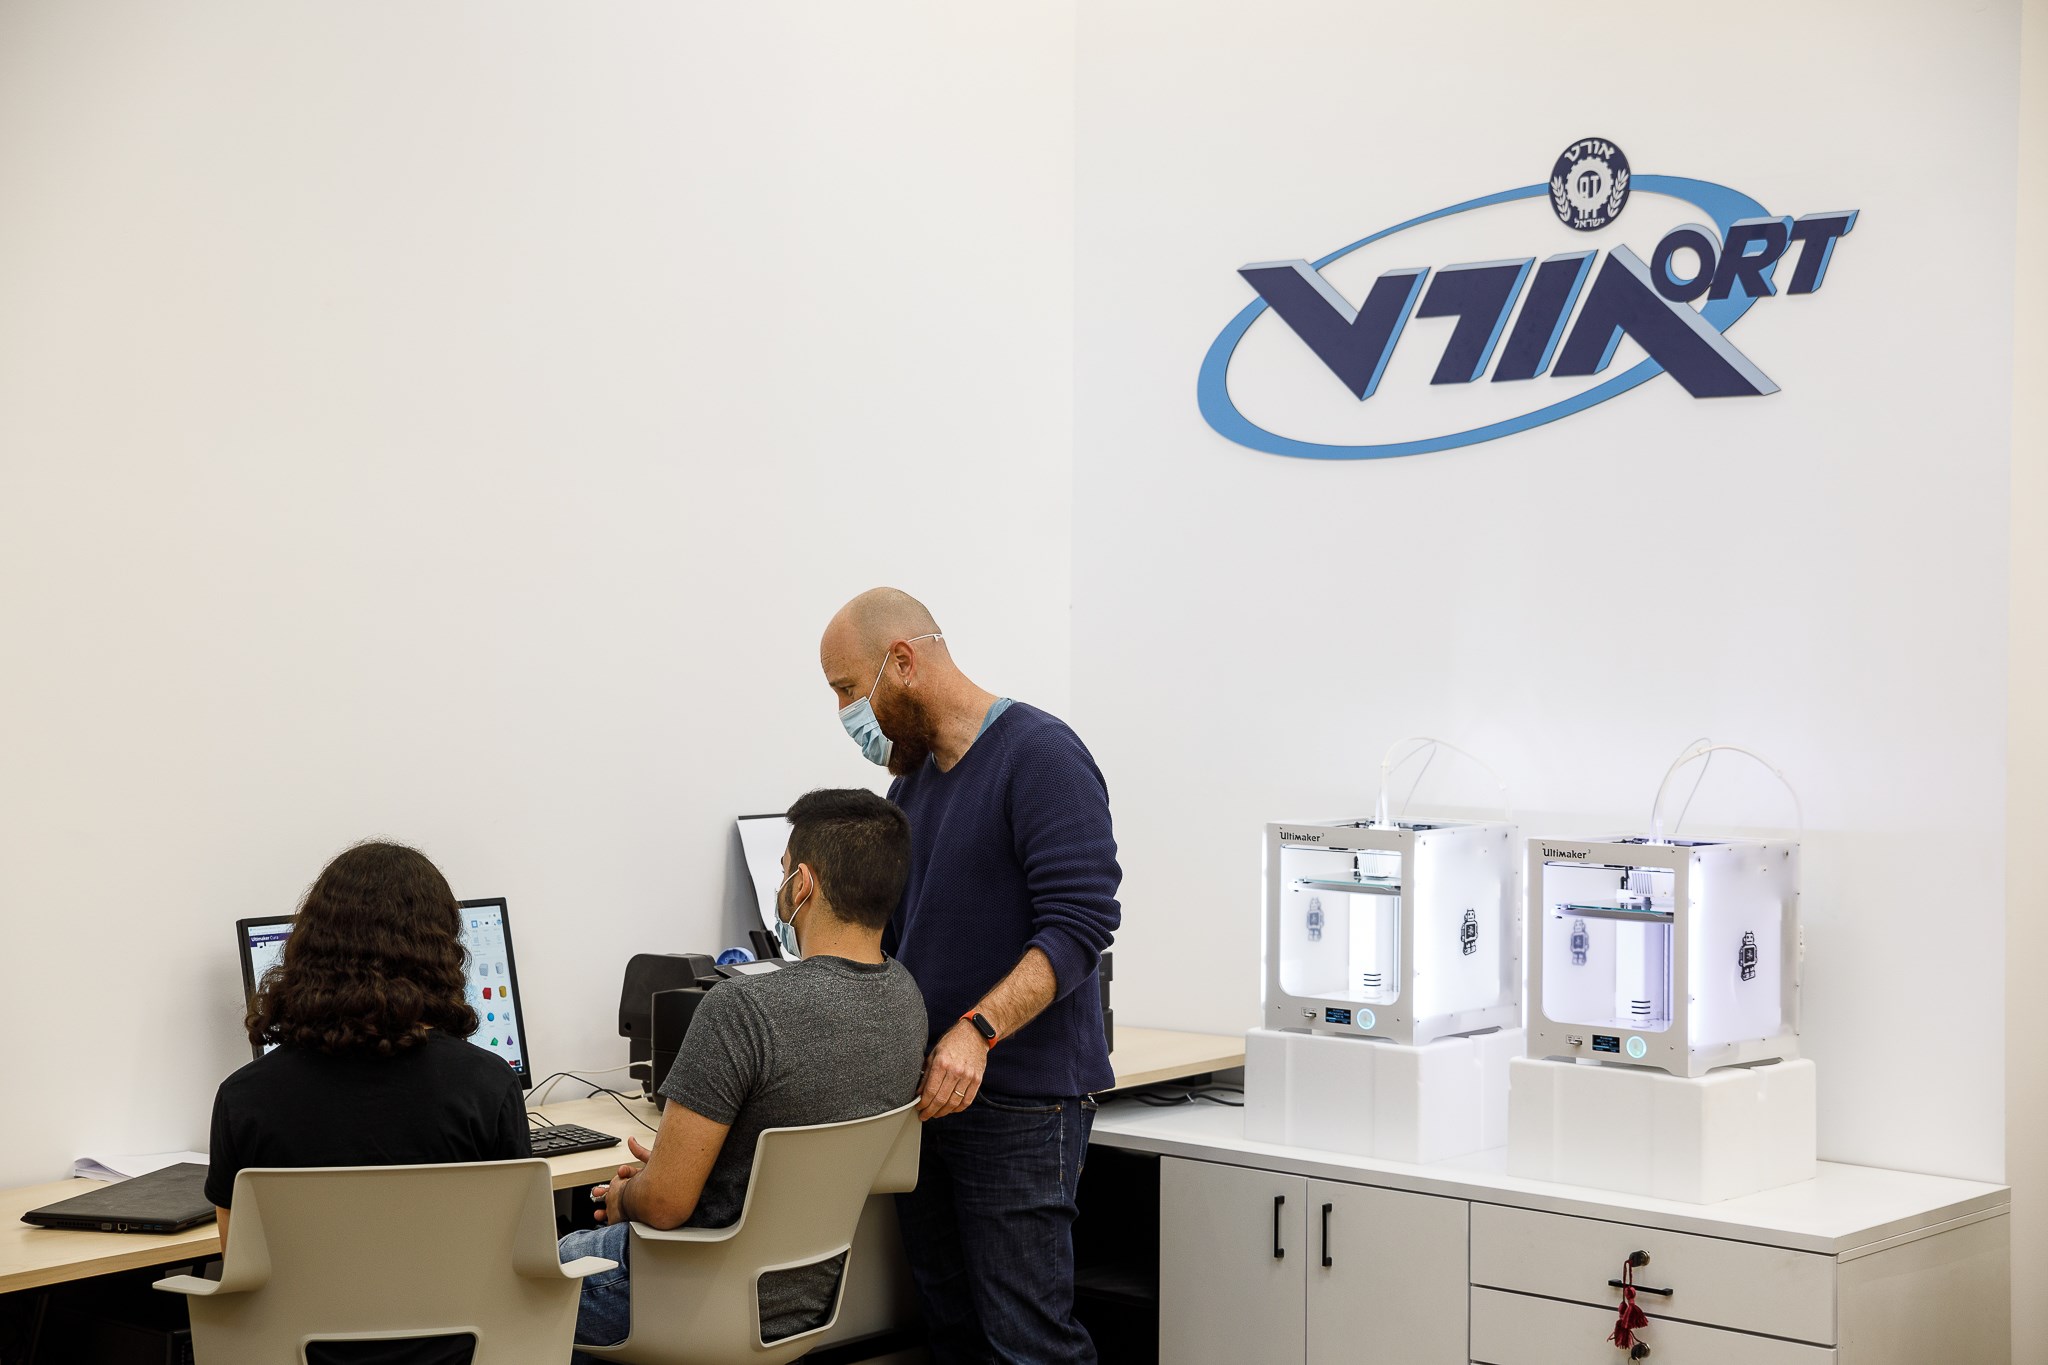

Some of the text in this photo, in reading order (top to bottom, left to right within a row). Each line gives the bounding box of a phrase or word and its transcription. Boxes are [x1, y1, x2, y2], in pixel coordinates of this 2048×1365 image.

[1564, 140, 1615, 162] אורט
[1574, 217, 1605, 229] ישראל
[1650, 209, 1859, 303] ORT
[1279, 831, 1321, 842] Ultimaker
[1542, 847, 1587, 859] Ultimaker
